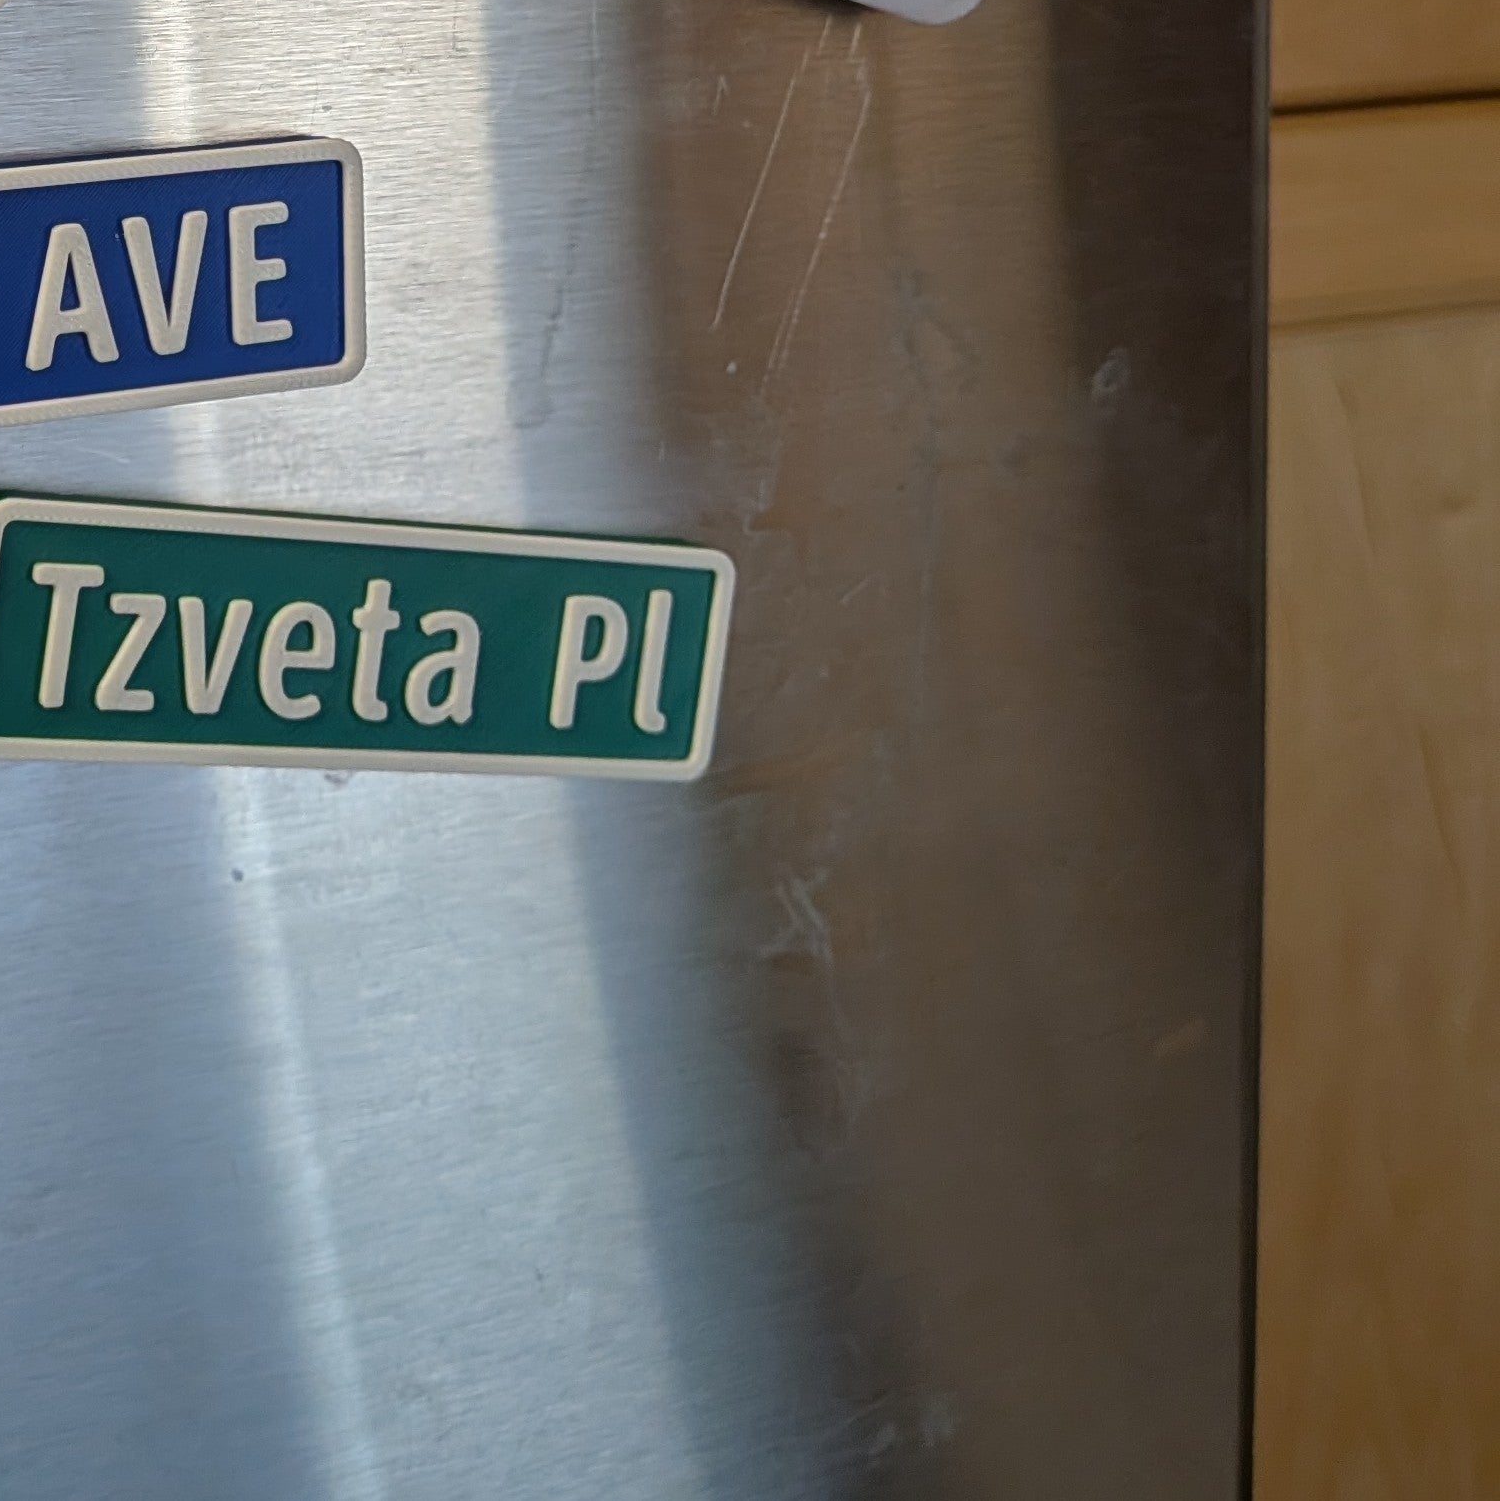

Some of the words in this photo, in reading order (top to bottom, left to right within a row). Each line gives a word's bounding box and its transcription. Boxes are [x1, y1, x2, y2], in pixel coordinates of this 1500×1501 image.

[24, 201, 294, 373] AVE
[31, 561, 482, 726] Tzveta
[549, 588, 672, 733] Pl
